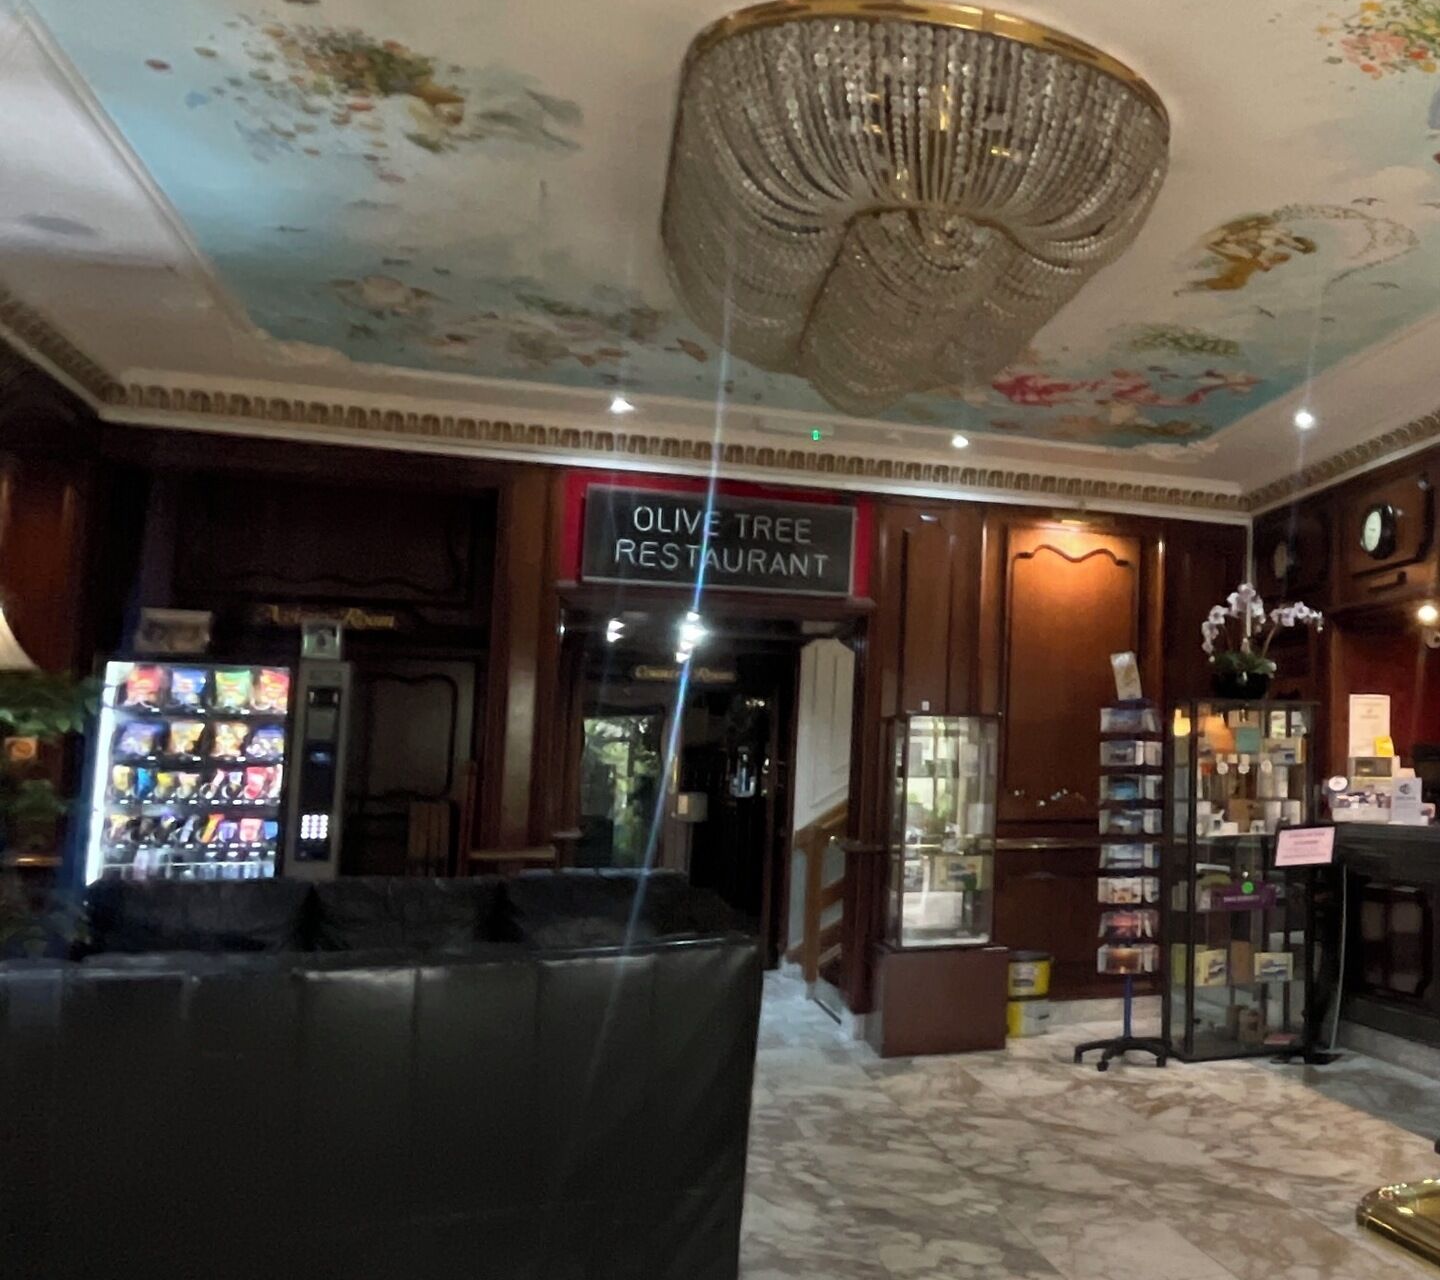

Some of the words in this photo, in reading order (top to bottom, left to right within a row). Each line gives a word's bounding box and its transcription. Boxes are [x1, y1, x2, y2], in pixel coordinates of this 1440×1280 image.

[633, 505, 723, 536] OLIVE
[734, 512, 812, 544] TREE
[614, 538, 829, 578] RESTAURANT
